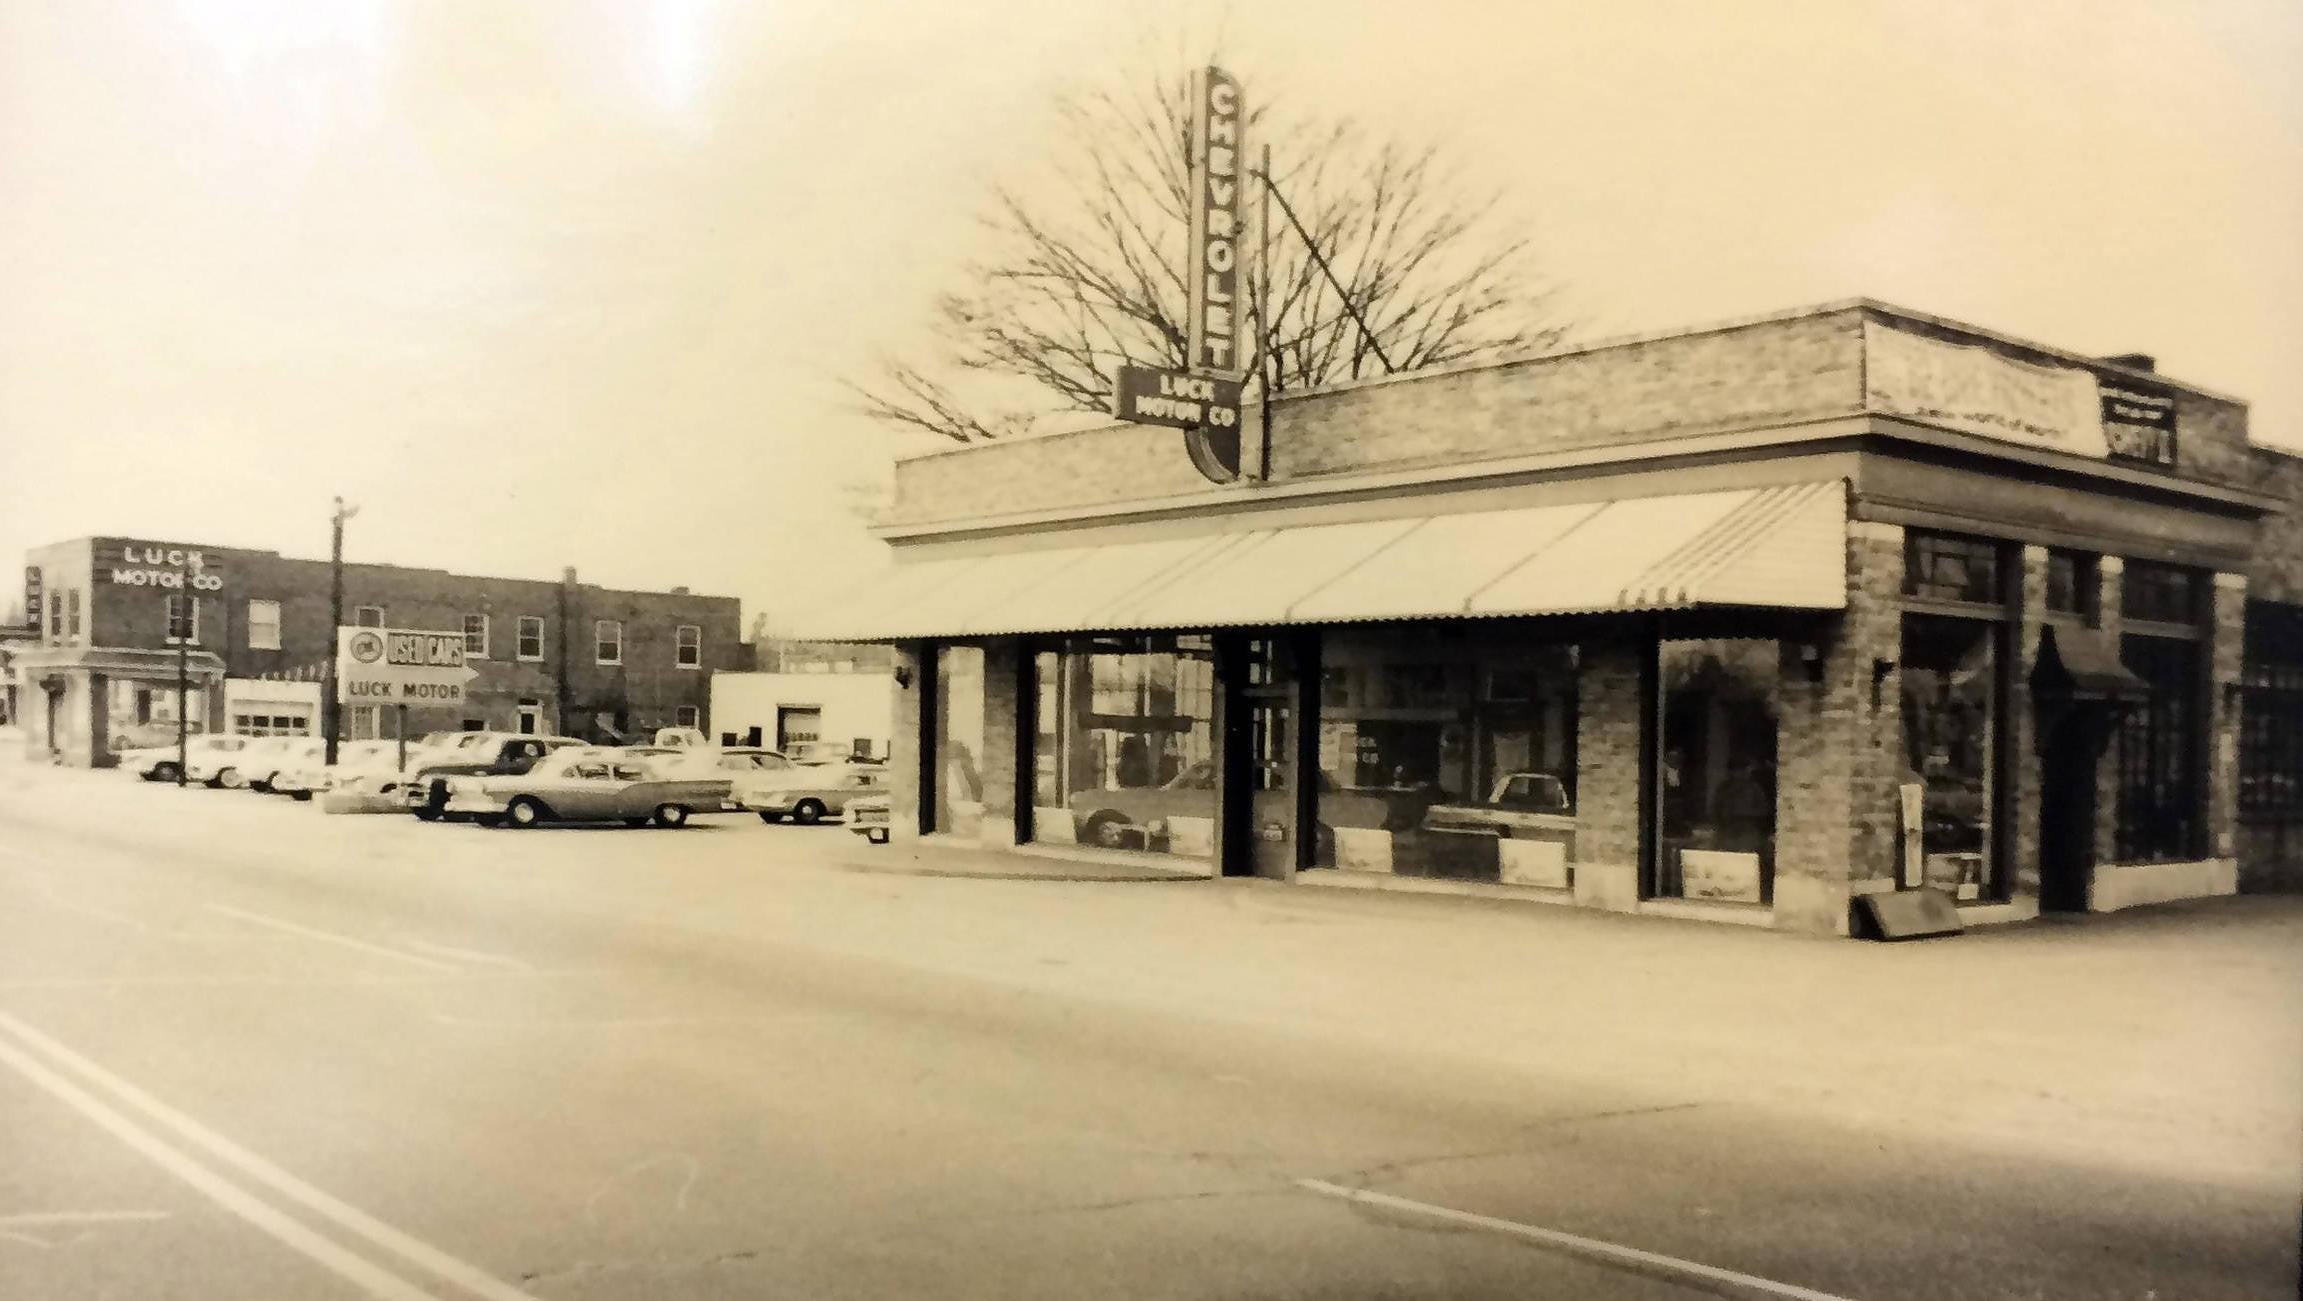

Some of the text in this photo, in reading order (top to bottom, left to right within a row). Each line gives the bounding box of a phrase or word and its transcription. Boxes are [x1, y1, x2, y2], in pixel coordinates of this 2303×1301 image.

[1206, 83, 1237, 367] CHEVROLET
[1160, 374, 1215, 402] LUCK
[1136, 395, 1236, 427] MOTOR CO
[124, 546, 204, 569] LUCK
[192, 574, 223, 590] CO
[348, 681, 460, 699] LUCK MOTOR
